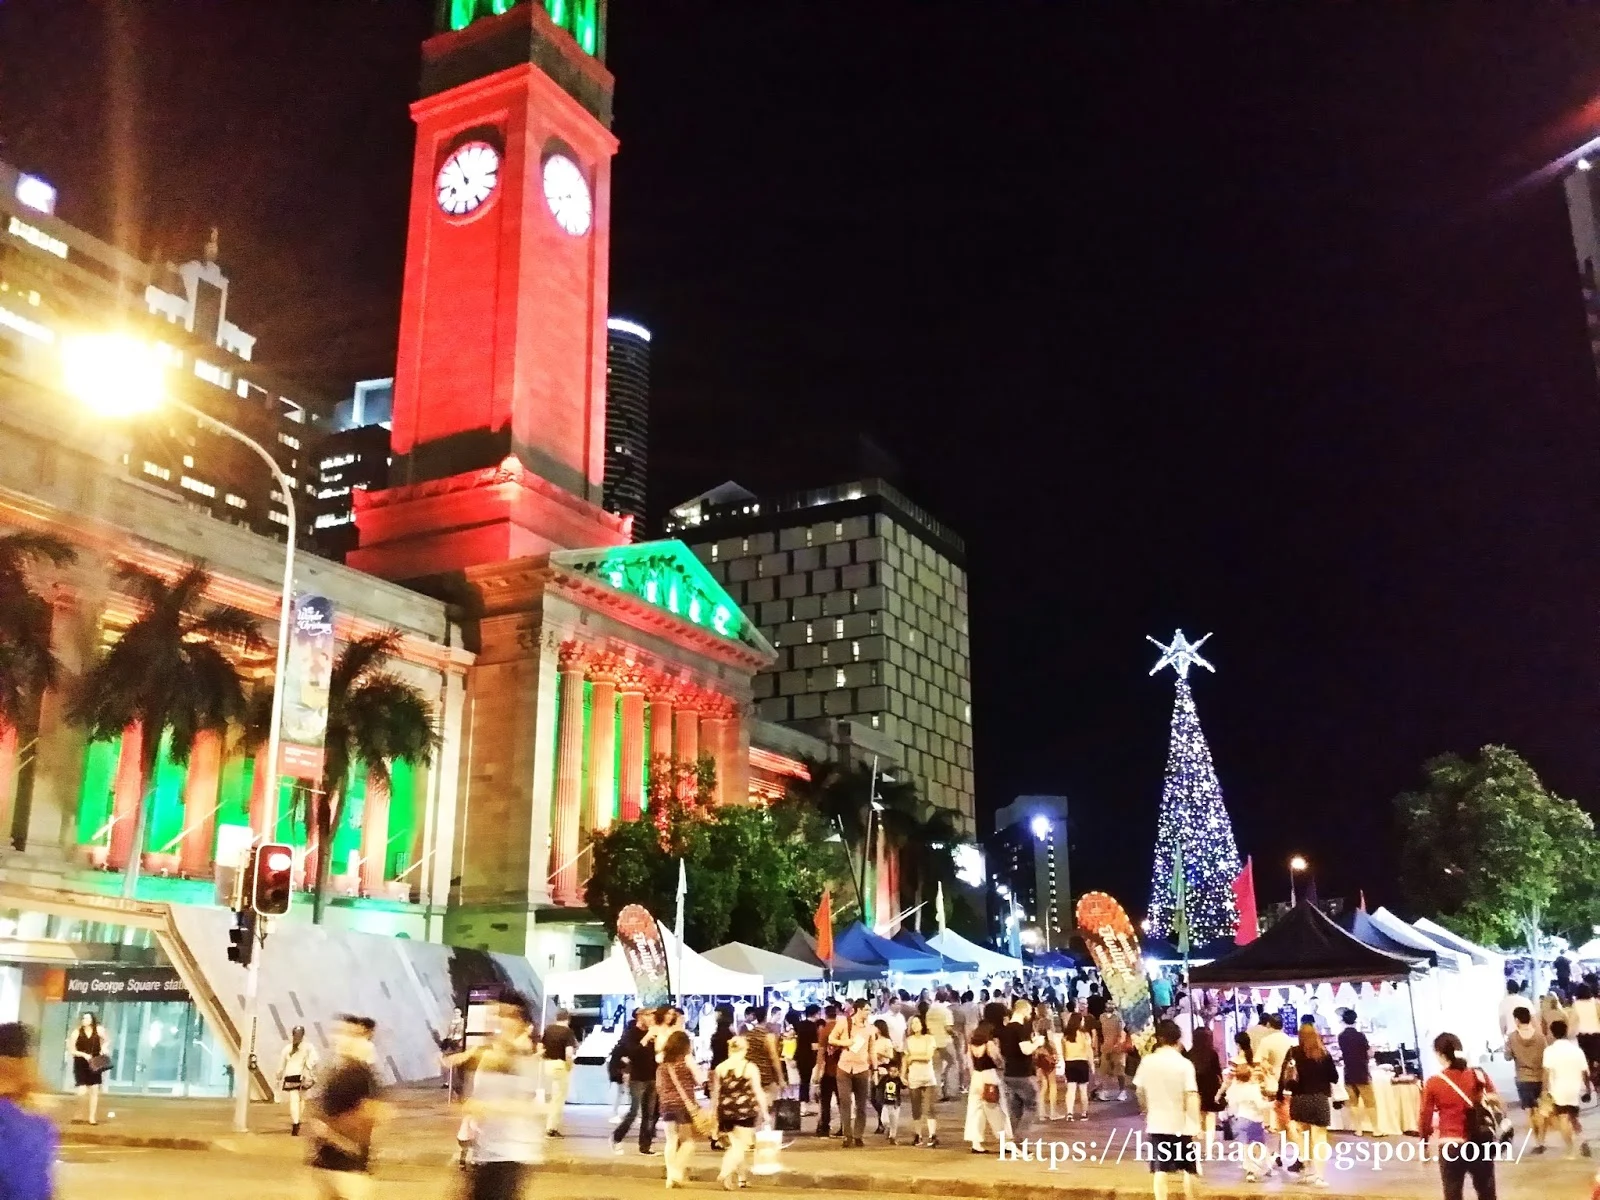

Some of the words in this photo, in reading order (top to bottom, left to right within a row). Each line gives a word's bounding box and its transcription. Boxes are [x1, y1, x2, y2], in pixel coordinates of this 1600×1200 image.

[1099, 924, 1136, 983] Twilight
[68, 979, 89, 993] King
[91, 979, 125, 993] George
[127, 979, 161, 993] Square
